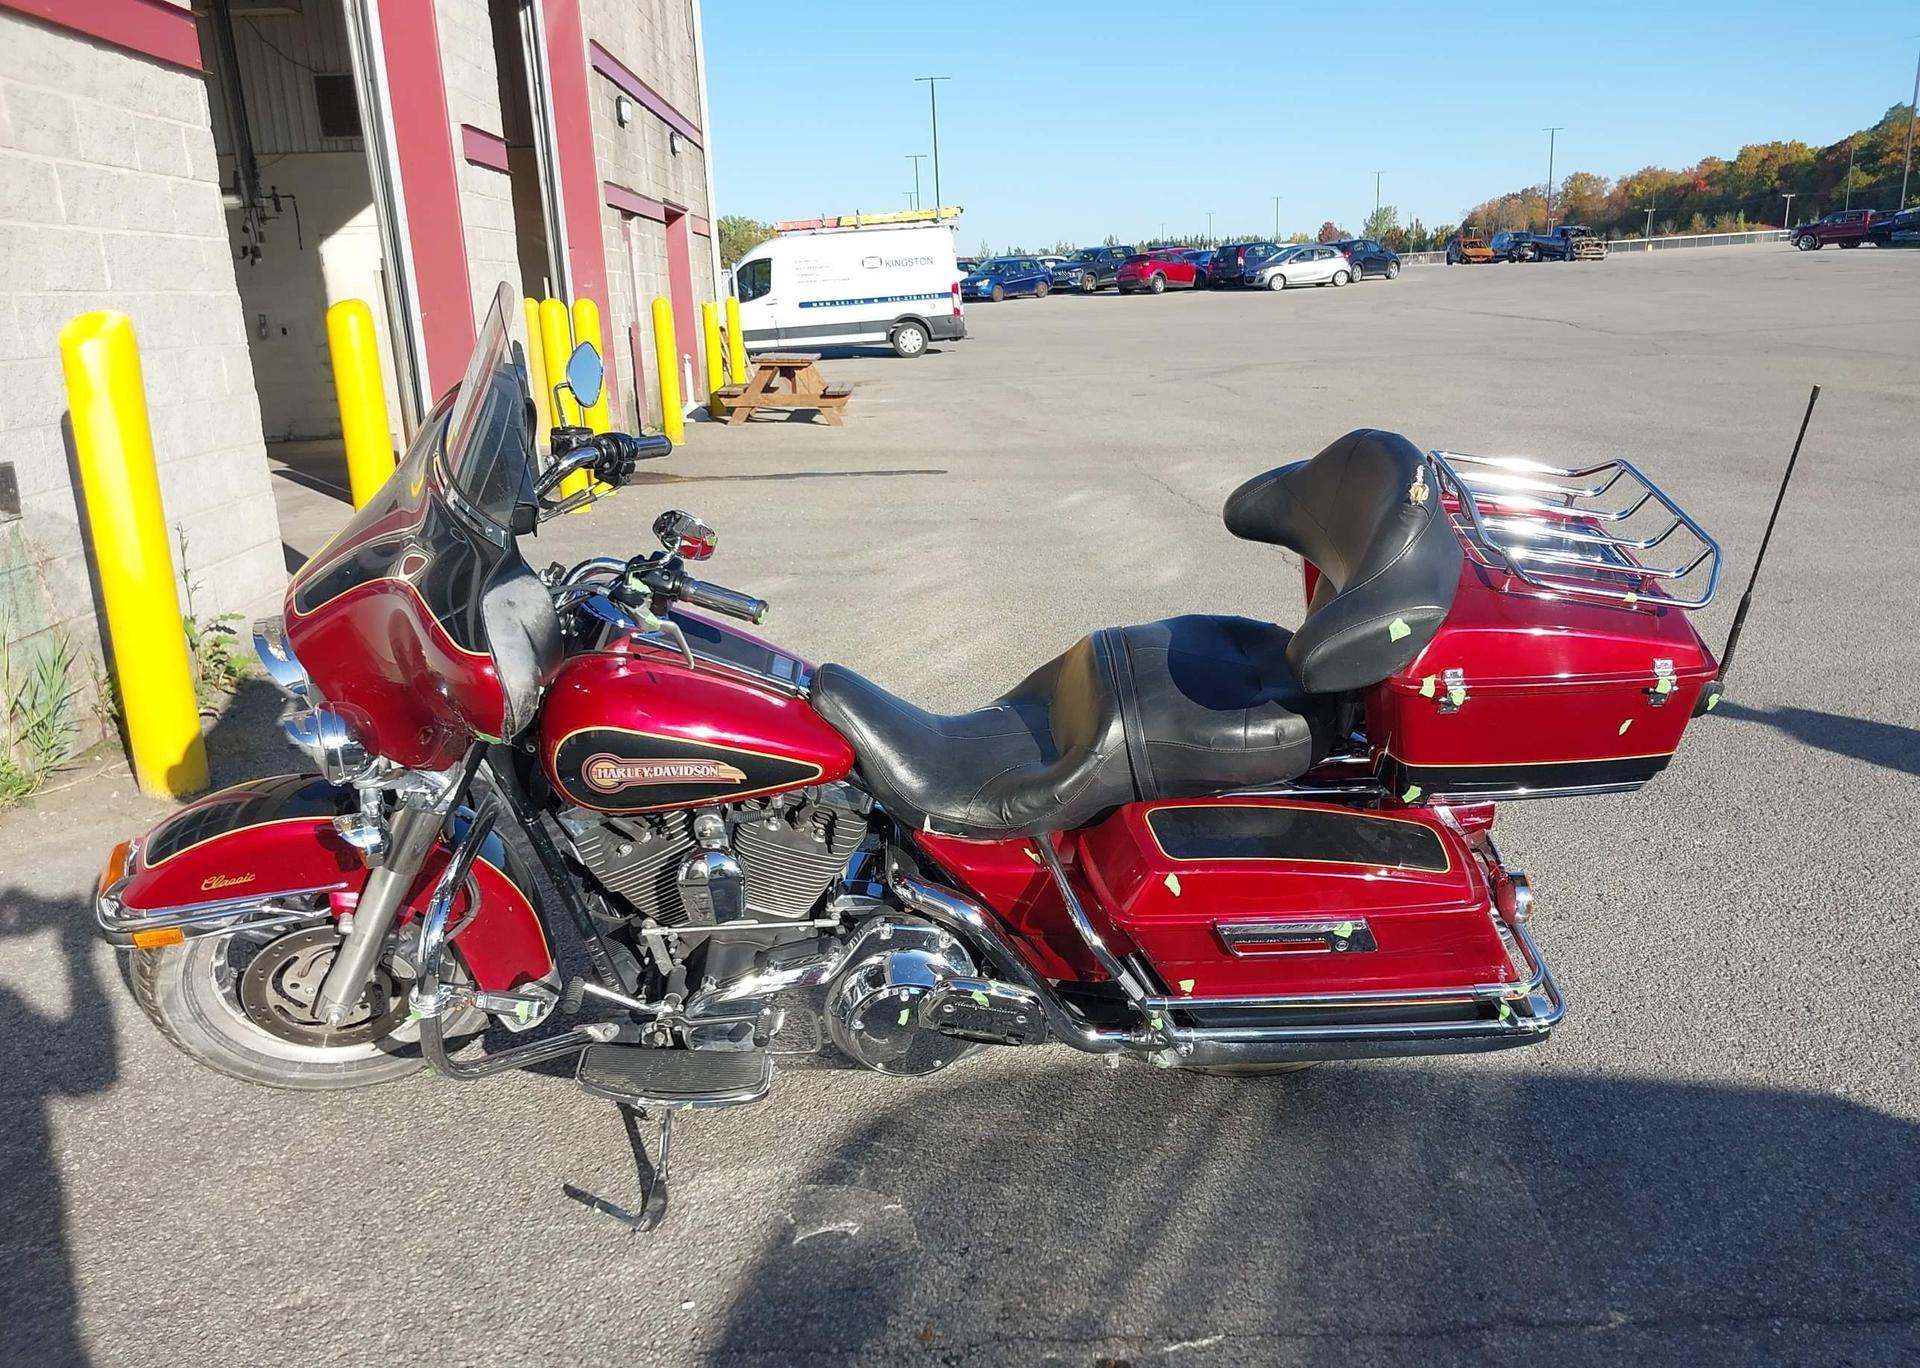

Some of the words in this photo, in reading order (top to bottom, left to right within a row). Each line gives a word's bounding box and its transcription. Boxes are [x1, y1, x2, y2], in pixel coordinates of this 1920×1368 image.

[885, 257, 934, 268] KINGSTON
[597, 765, 720, 779] HARLEY-DAVIDSON
[200, 872, 256, 891] Classic
